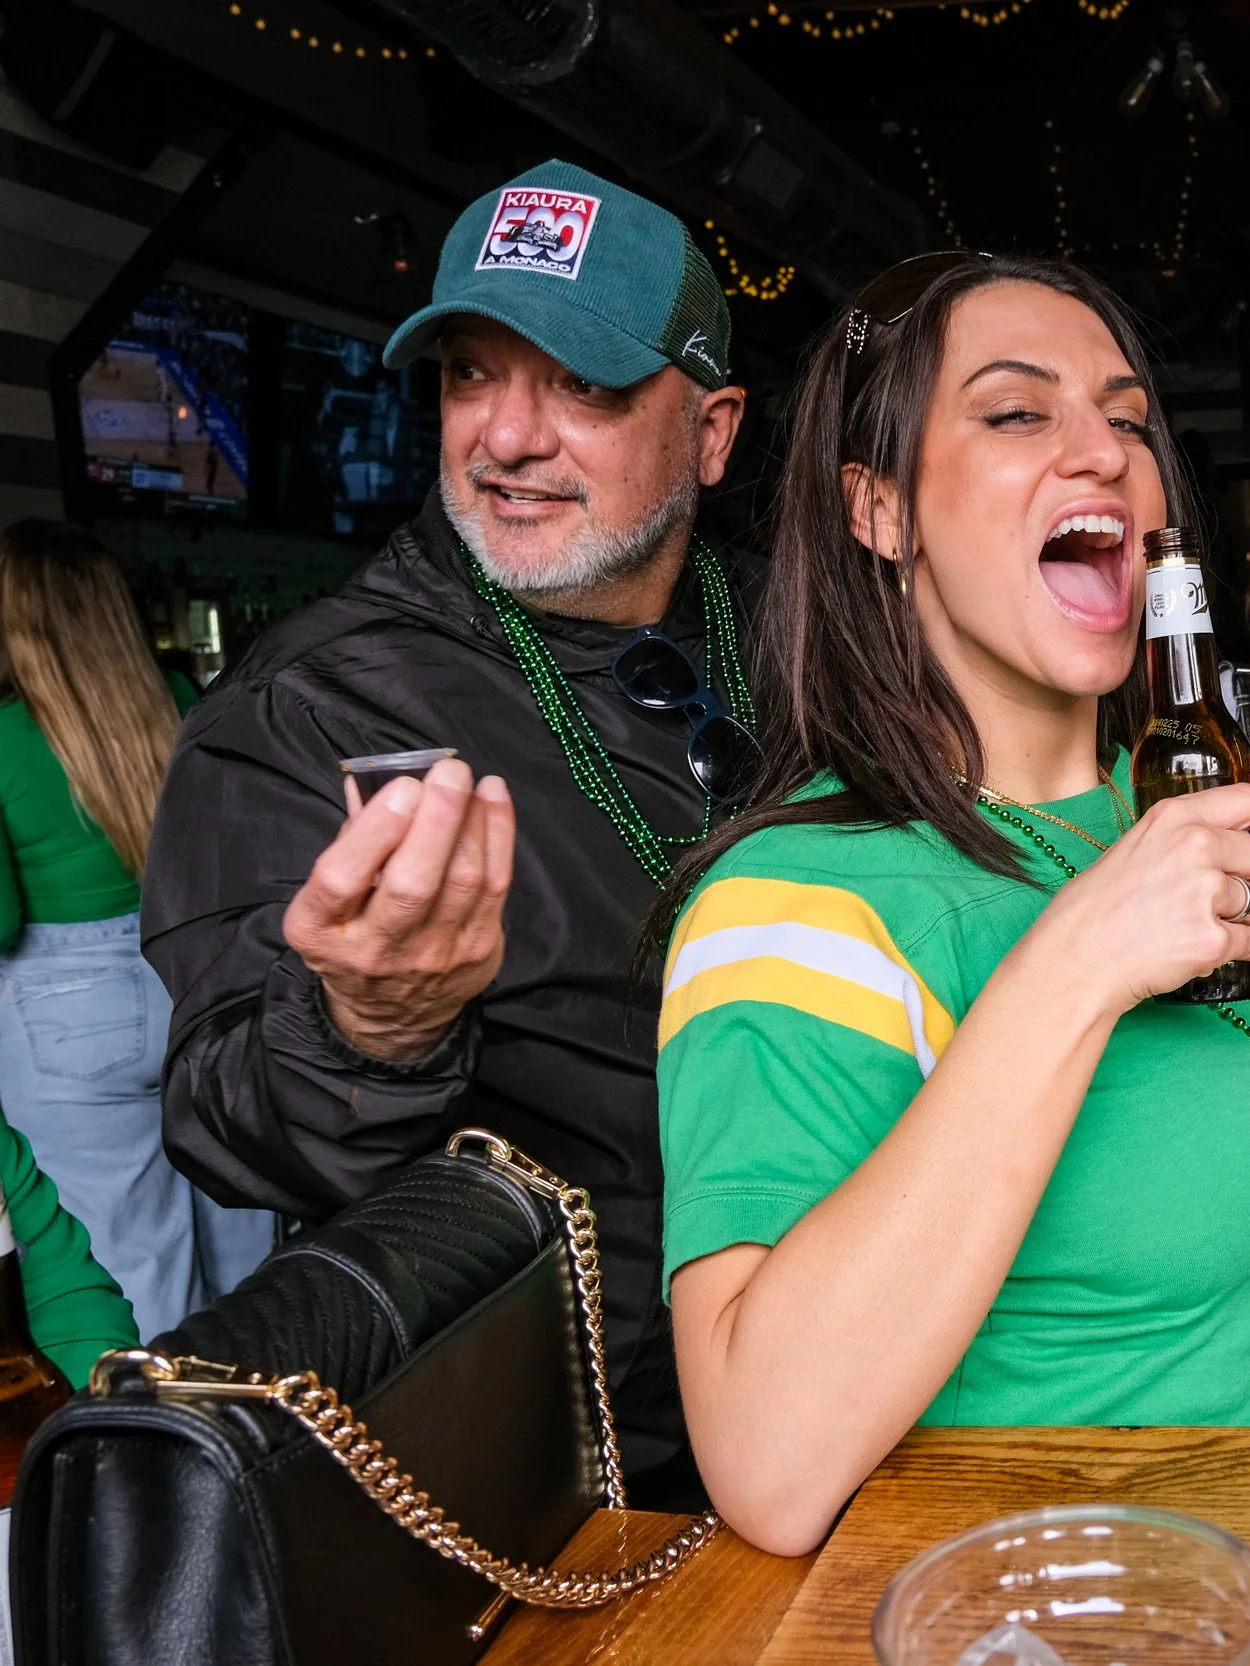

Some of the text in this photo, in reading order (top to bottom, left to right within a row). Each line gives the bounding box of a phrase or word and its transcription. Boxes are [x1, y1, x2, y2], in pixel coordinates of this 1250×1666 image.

[505, 193, 588, 214] KIAURA
[490, 207, 584, 262] 500
[484, 256, 496, 264] A
